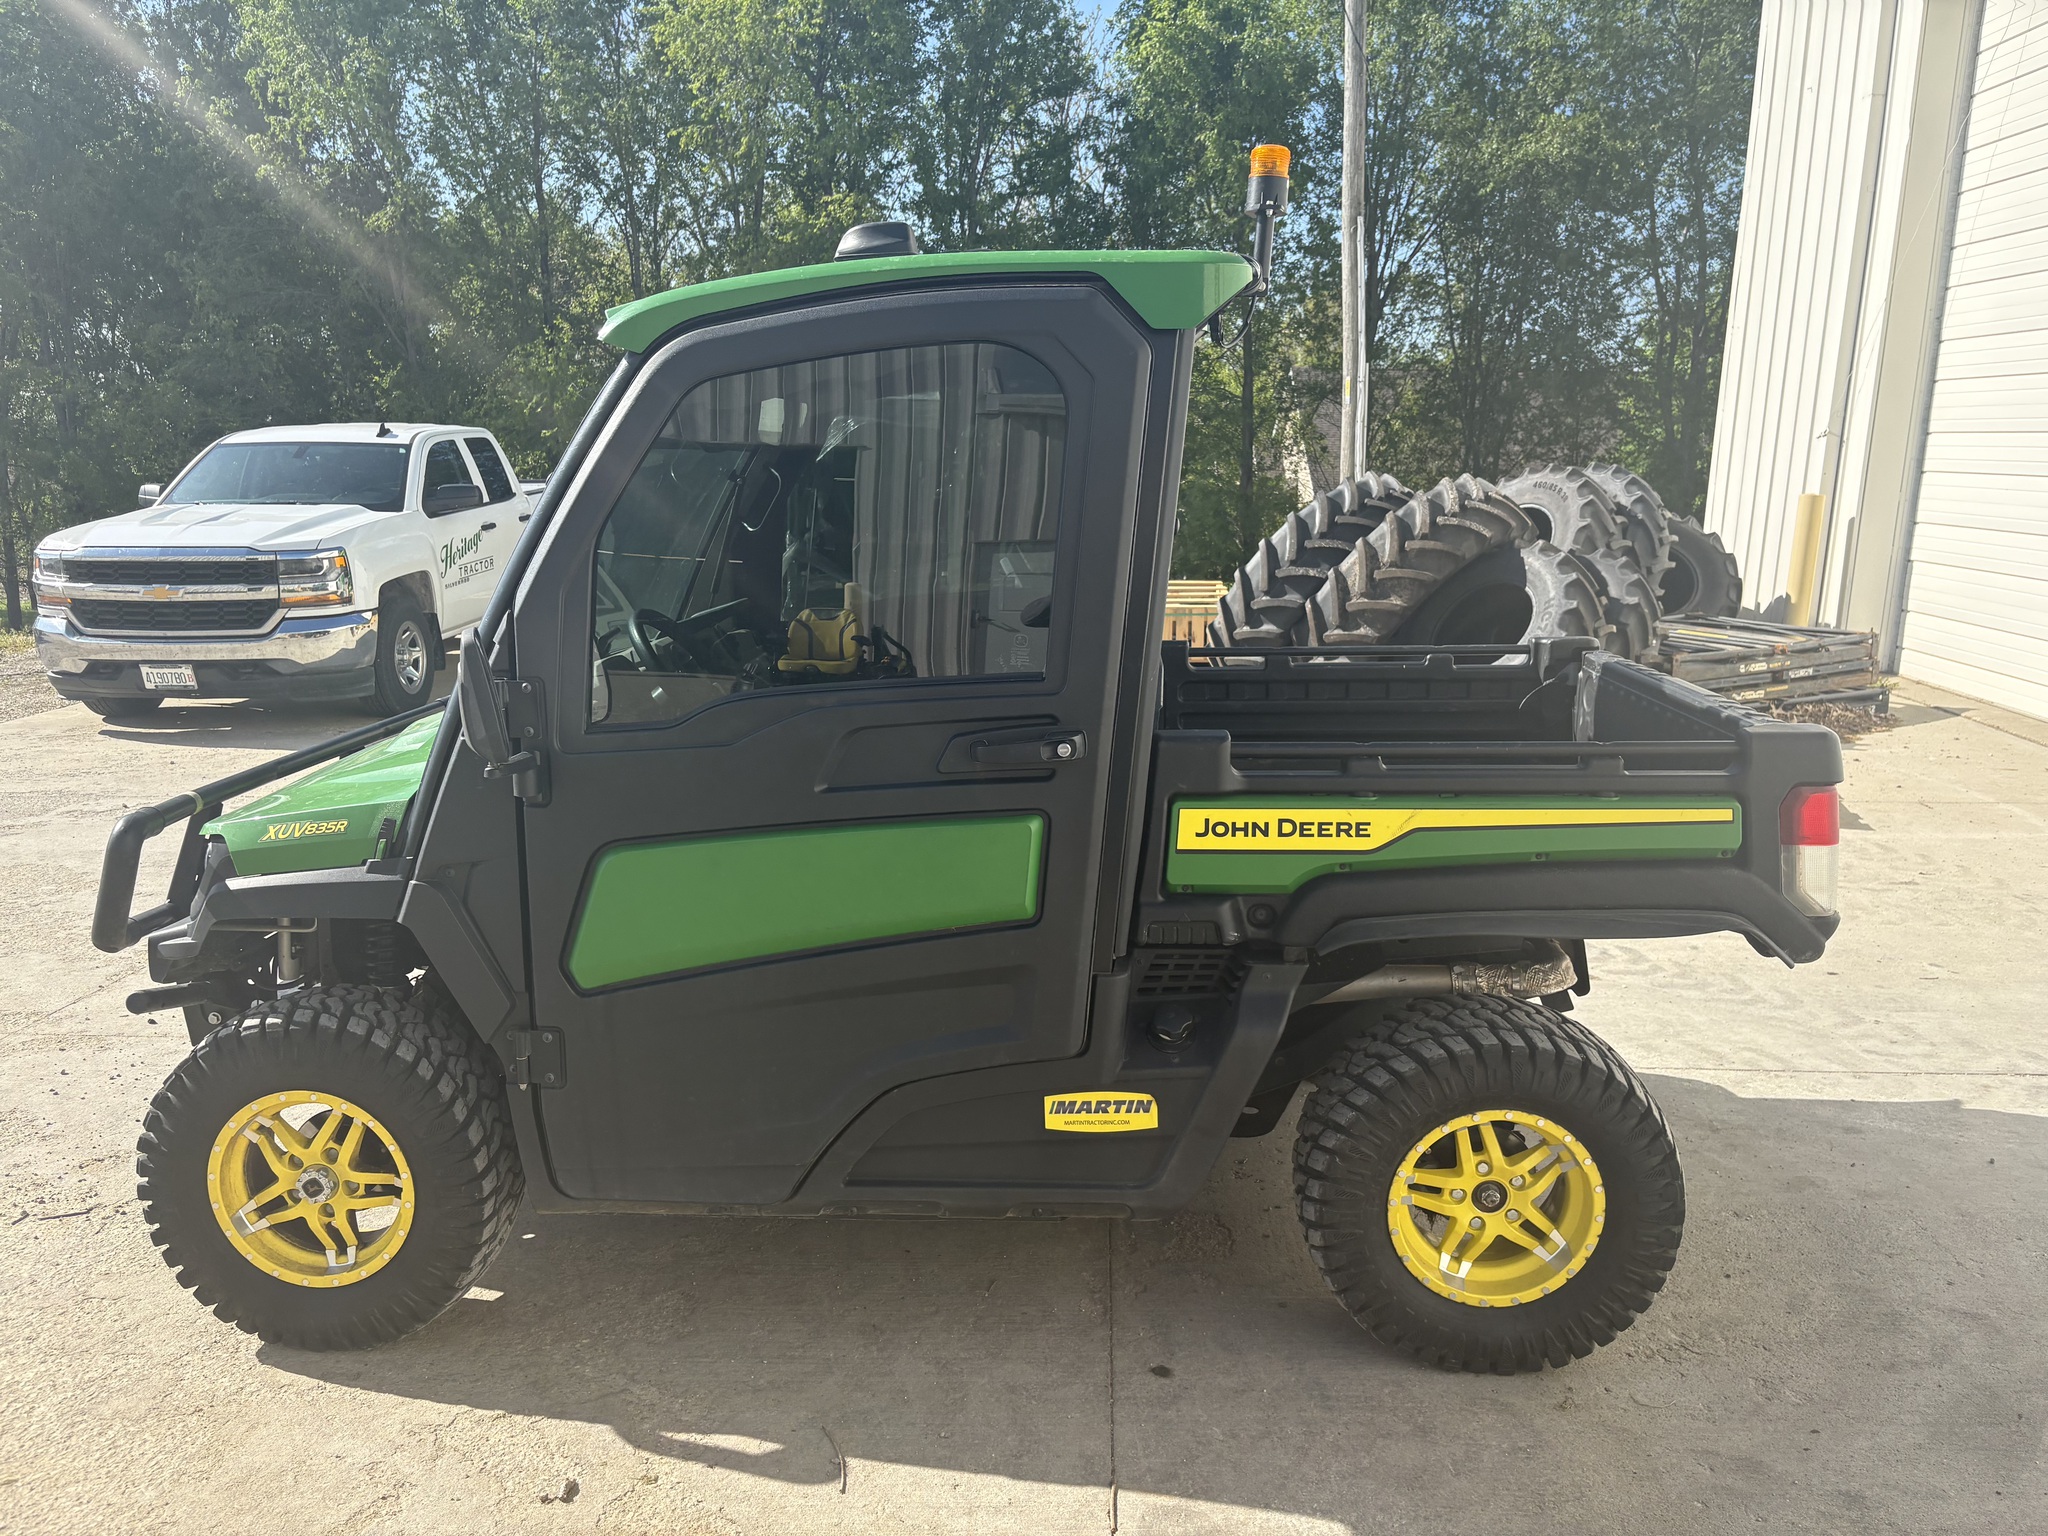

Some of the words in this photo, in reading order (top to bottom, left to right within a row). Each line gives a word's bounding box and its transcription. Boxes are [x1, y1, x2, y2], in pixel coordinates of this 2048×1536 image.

[440, 529, 483, 579] Heritage
[459, 559, 494, 577] TRACTOR
[260, 820, 348, 841] XUV835R
[1195, 818, 1269, 838] JOHN
[1277, 818, 1372, 838] DEERE
[1053, 1100, 1153, 1114] MARTIN
[1063, 1119, 1131, 1127] MARTINTRACTORINC.COM
